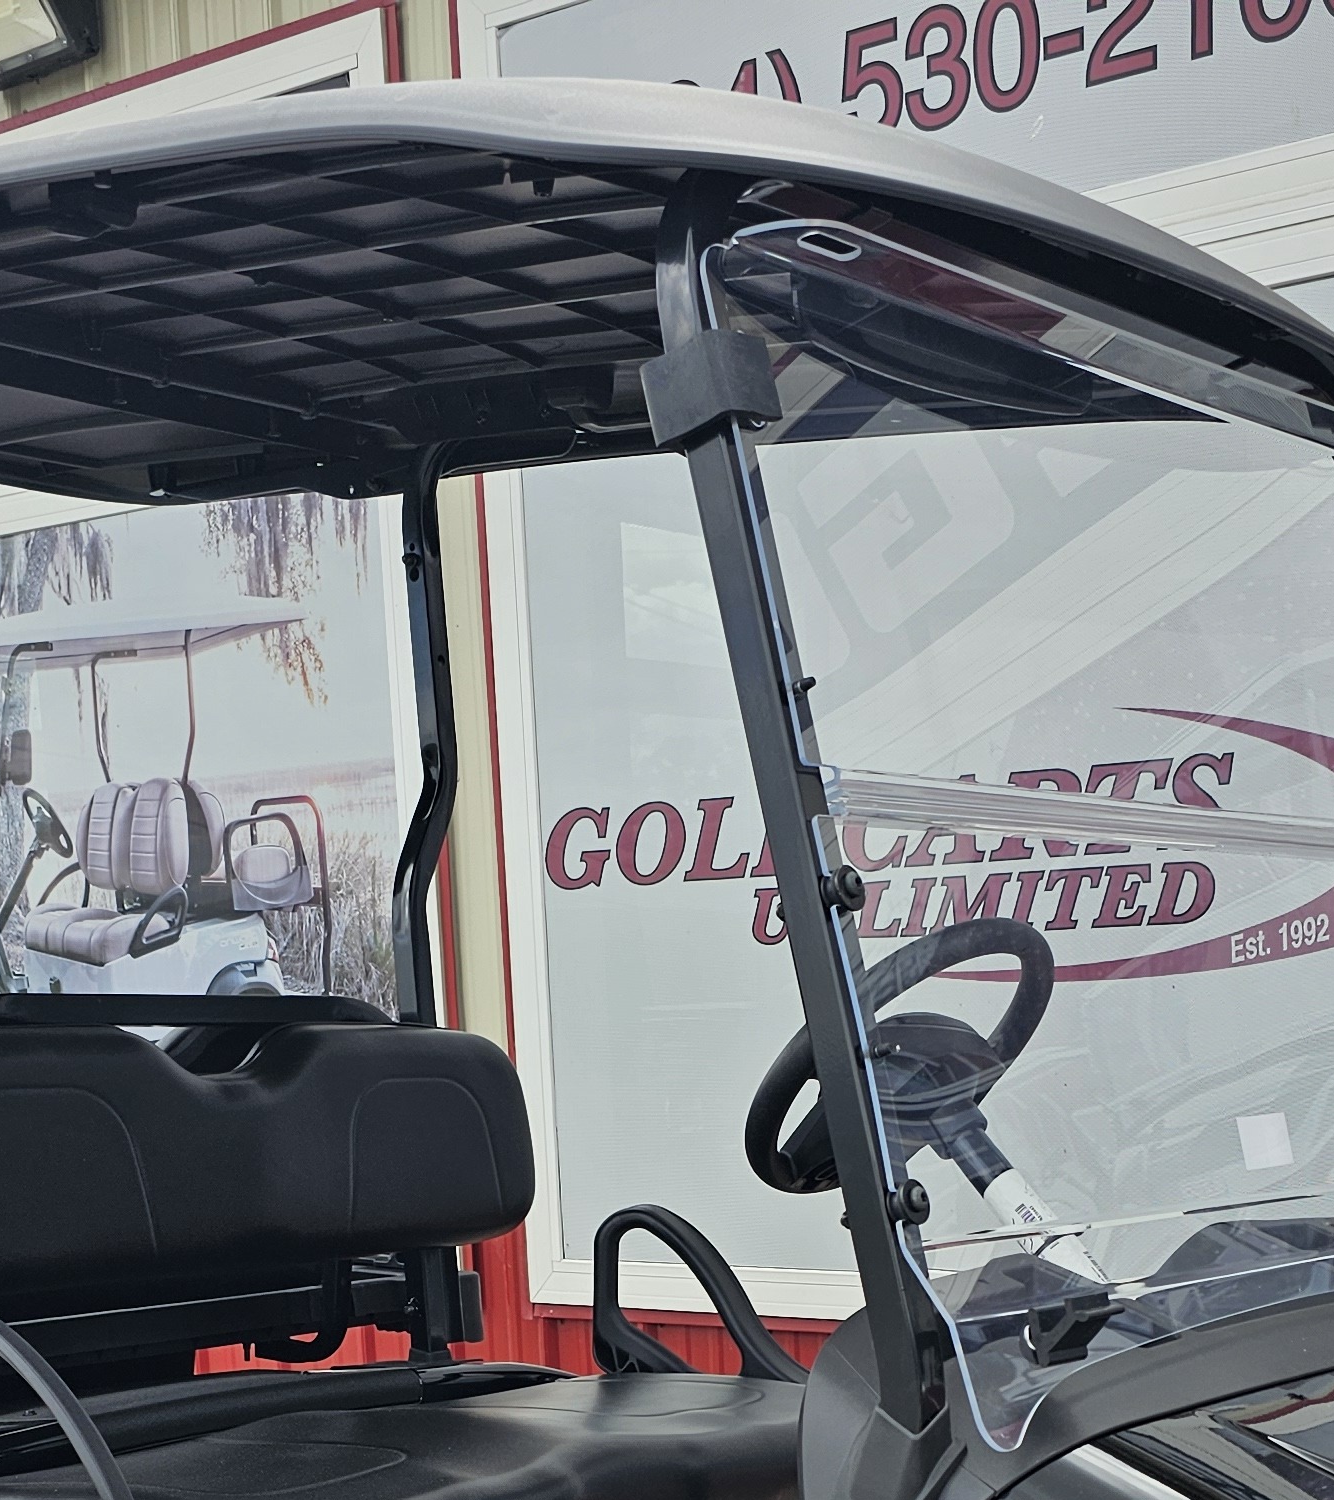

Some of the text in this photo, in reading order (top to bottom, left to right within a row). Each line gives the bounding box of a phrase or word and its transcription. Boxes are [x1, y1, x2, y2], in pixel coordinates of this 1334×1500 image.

[545, 797, 775, 890] GOL
[752, 861, 1216, 946] ULIMITED
[1230, 913, 1330, 964] Est. 1992
